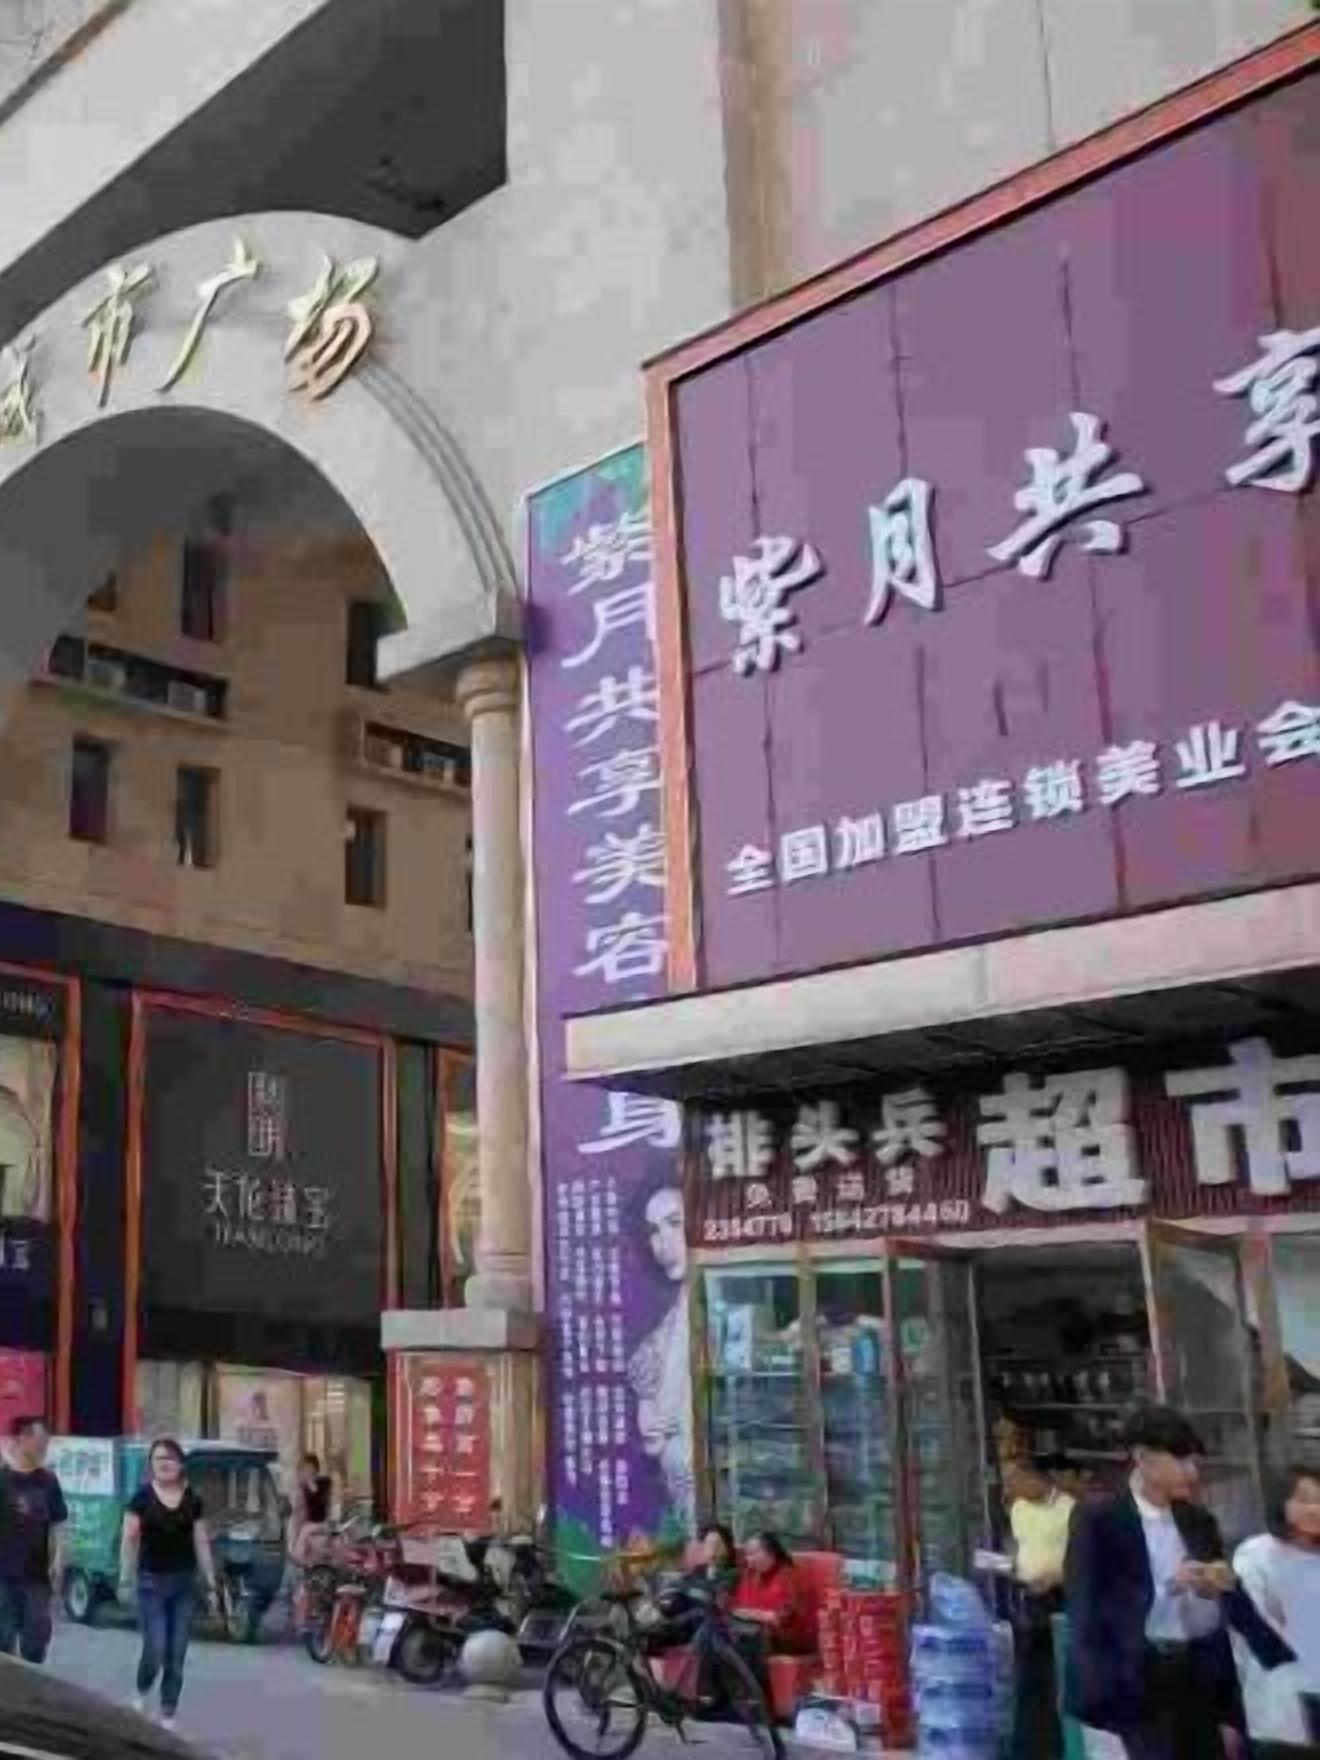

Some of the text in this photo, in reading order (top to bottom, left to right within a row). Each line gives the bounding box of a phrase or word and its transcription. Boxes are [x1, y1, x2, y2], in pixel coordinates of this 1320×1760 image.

[718, 326, 1320, 676] 紫月共享
[725, 699, 1320, 896] 全国加盟连锁美业会
[705, 1036, 1320, 1215] 排头兵 超市
